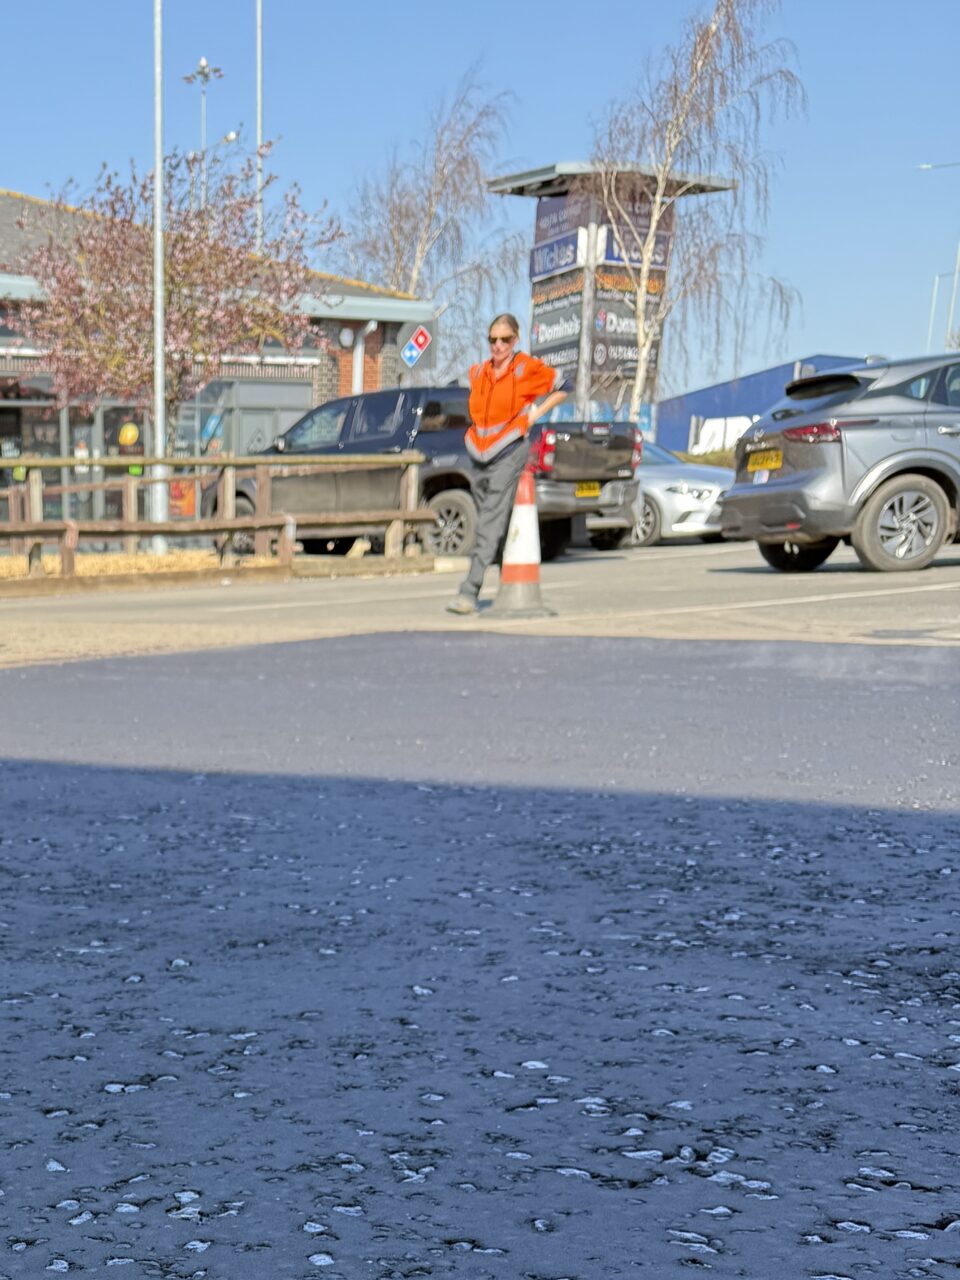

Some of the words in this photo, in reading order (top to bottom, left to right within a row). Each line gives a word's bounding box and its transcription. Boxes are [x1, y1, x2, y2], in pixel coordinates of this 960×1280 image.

[533, 243, 575, 277] Wickes
[611, 234, 666, 264] Wics
[539, 313, 581, 343] Domino's
[606, 311, 661, 335] Domos
